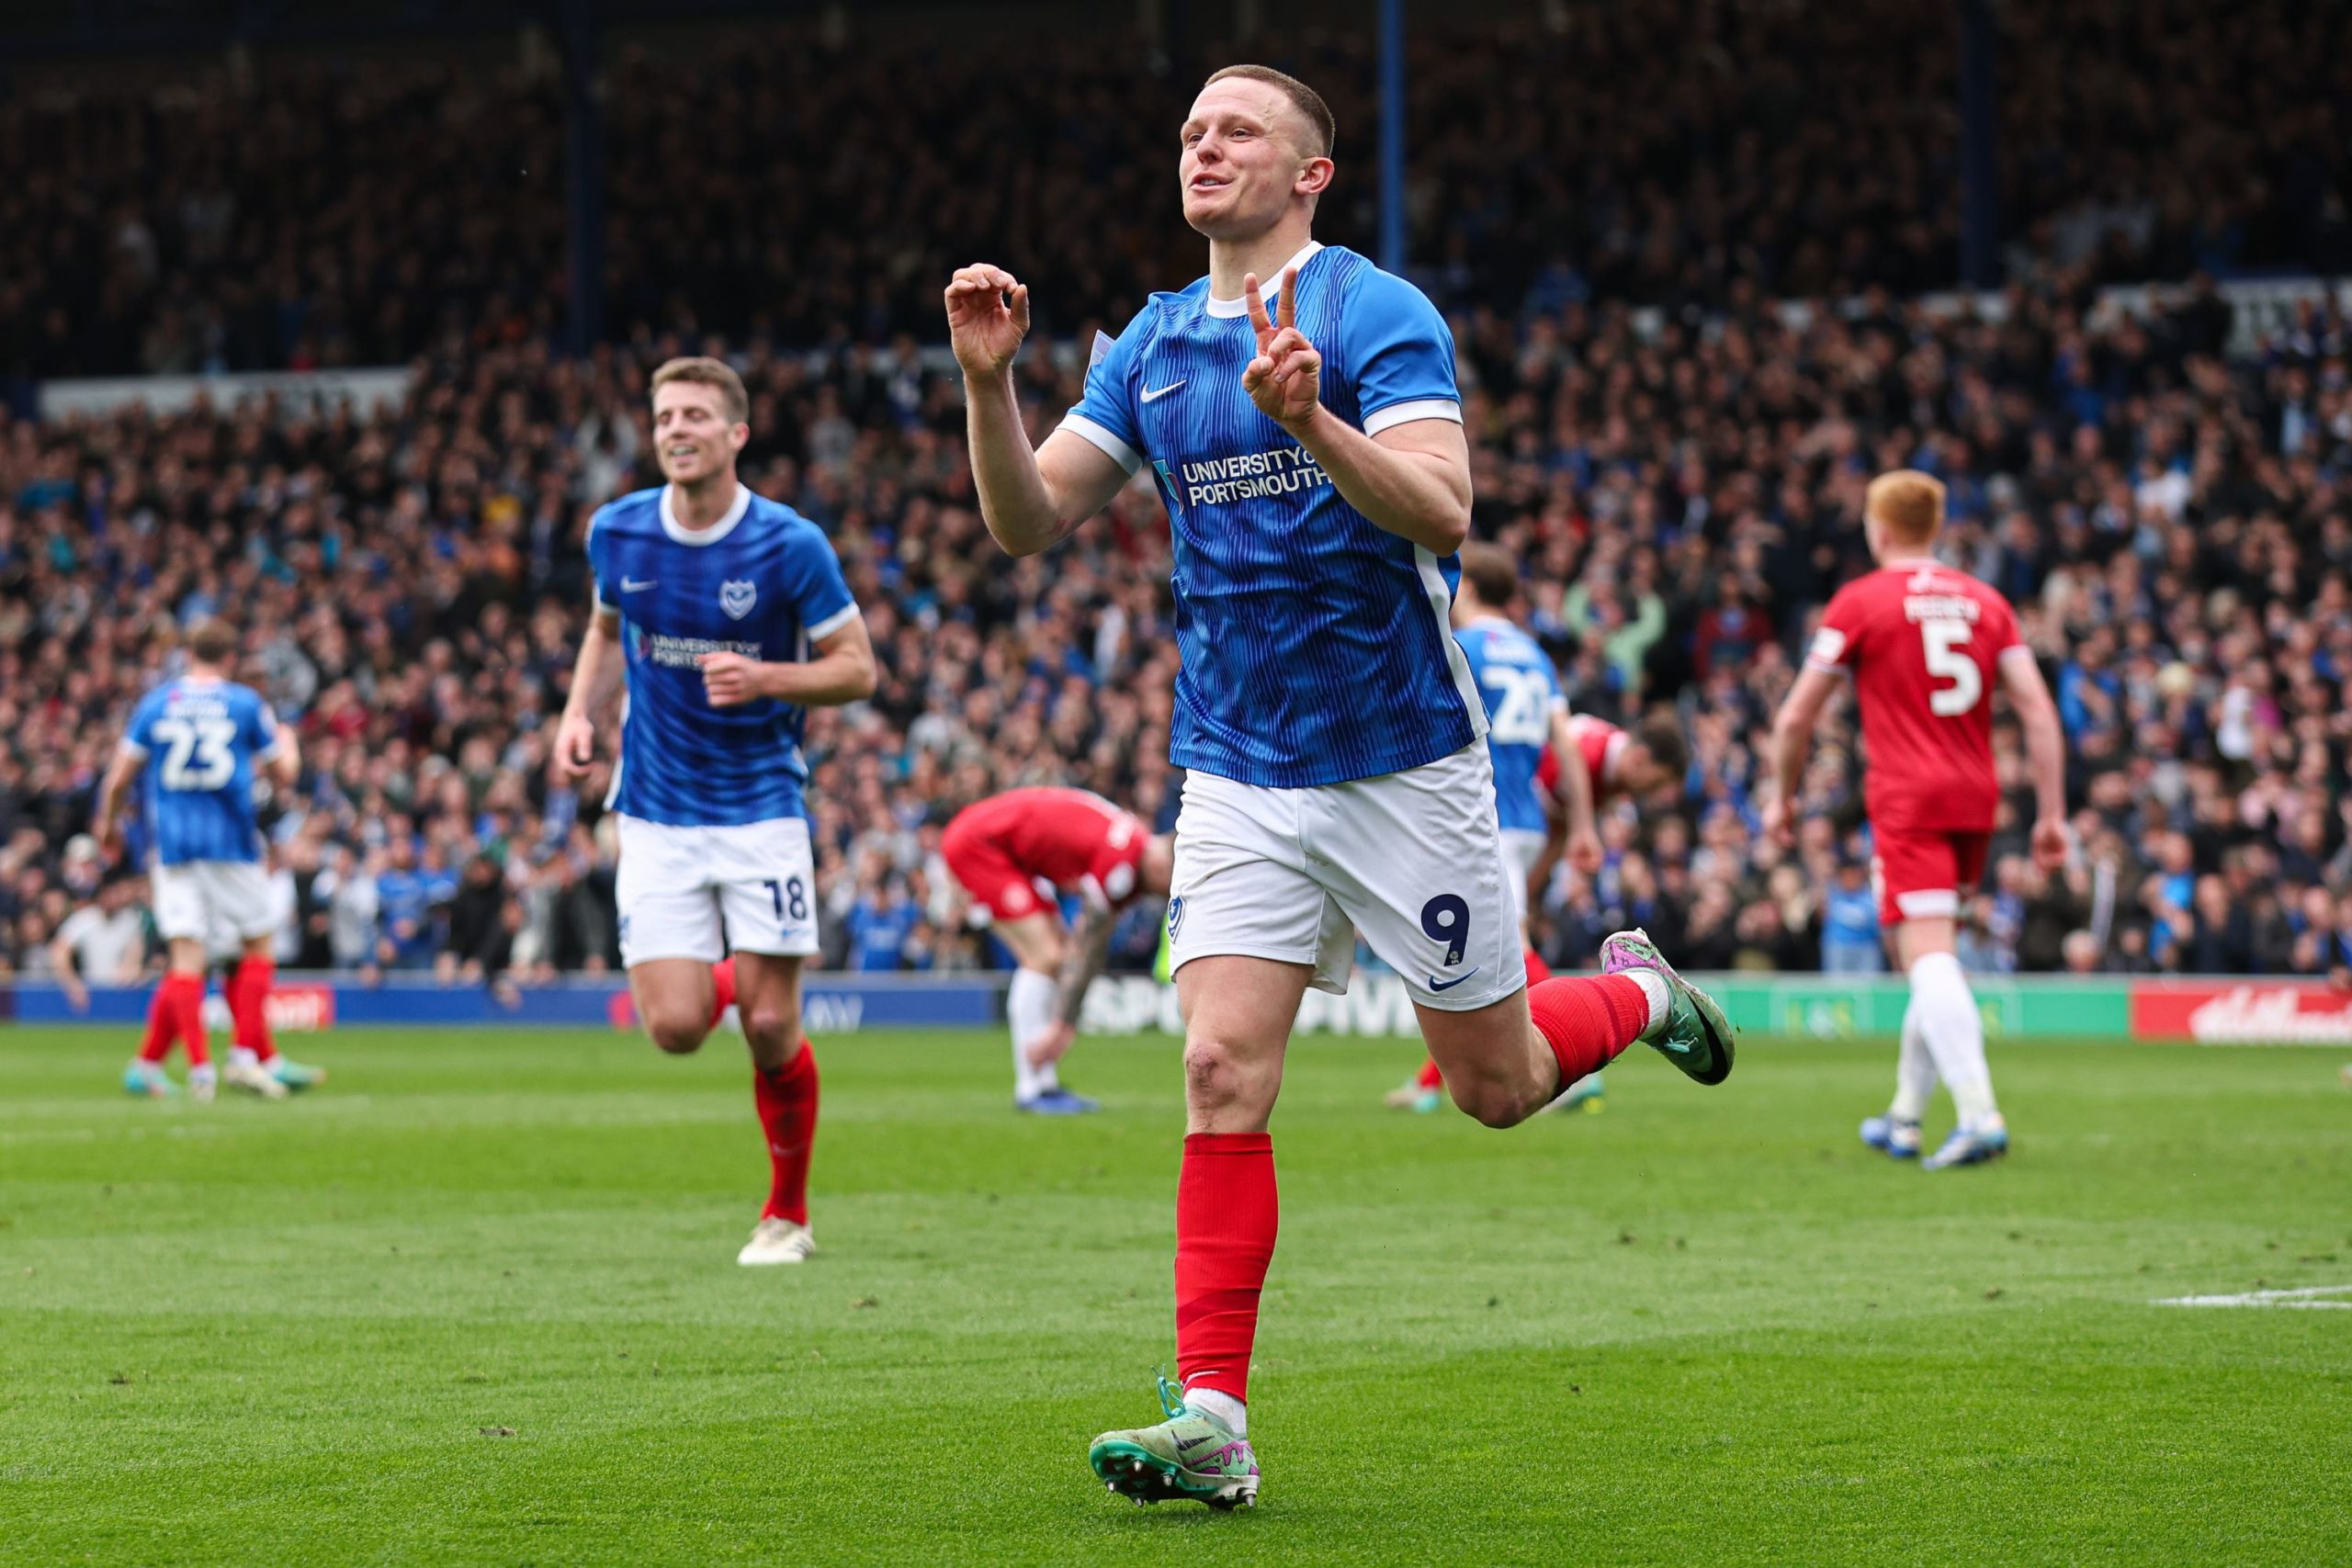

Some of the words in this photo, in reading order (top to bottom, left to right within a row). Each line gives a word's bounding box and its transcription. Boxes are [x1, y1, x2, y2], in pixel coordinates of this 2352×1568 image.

[1182, 446, 1301, 483] UNIVERSITY
[1188, 466, 1332, 506] PORTSMOUTH
[1919, 619, 1982, 717] 5
[150, 717, 237, 792] 23
[763, 876, 807, 921] 18
[1420, 893, 1470, 967] 9
